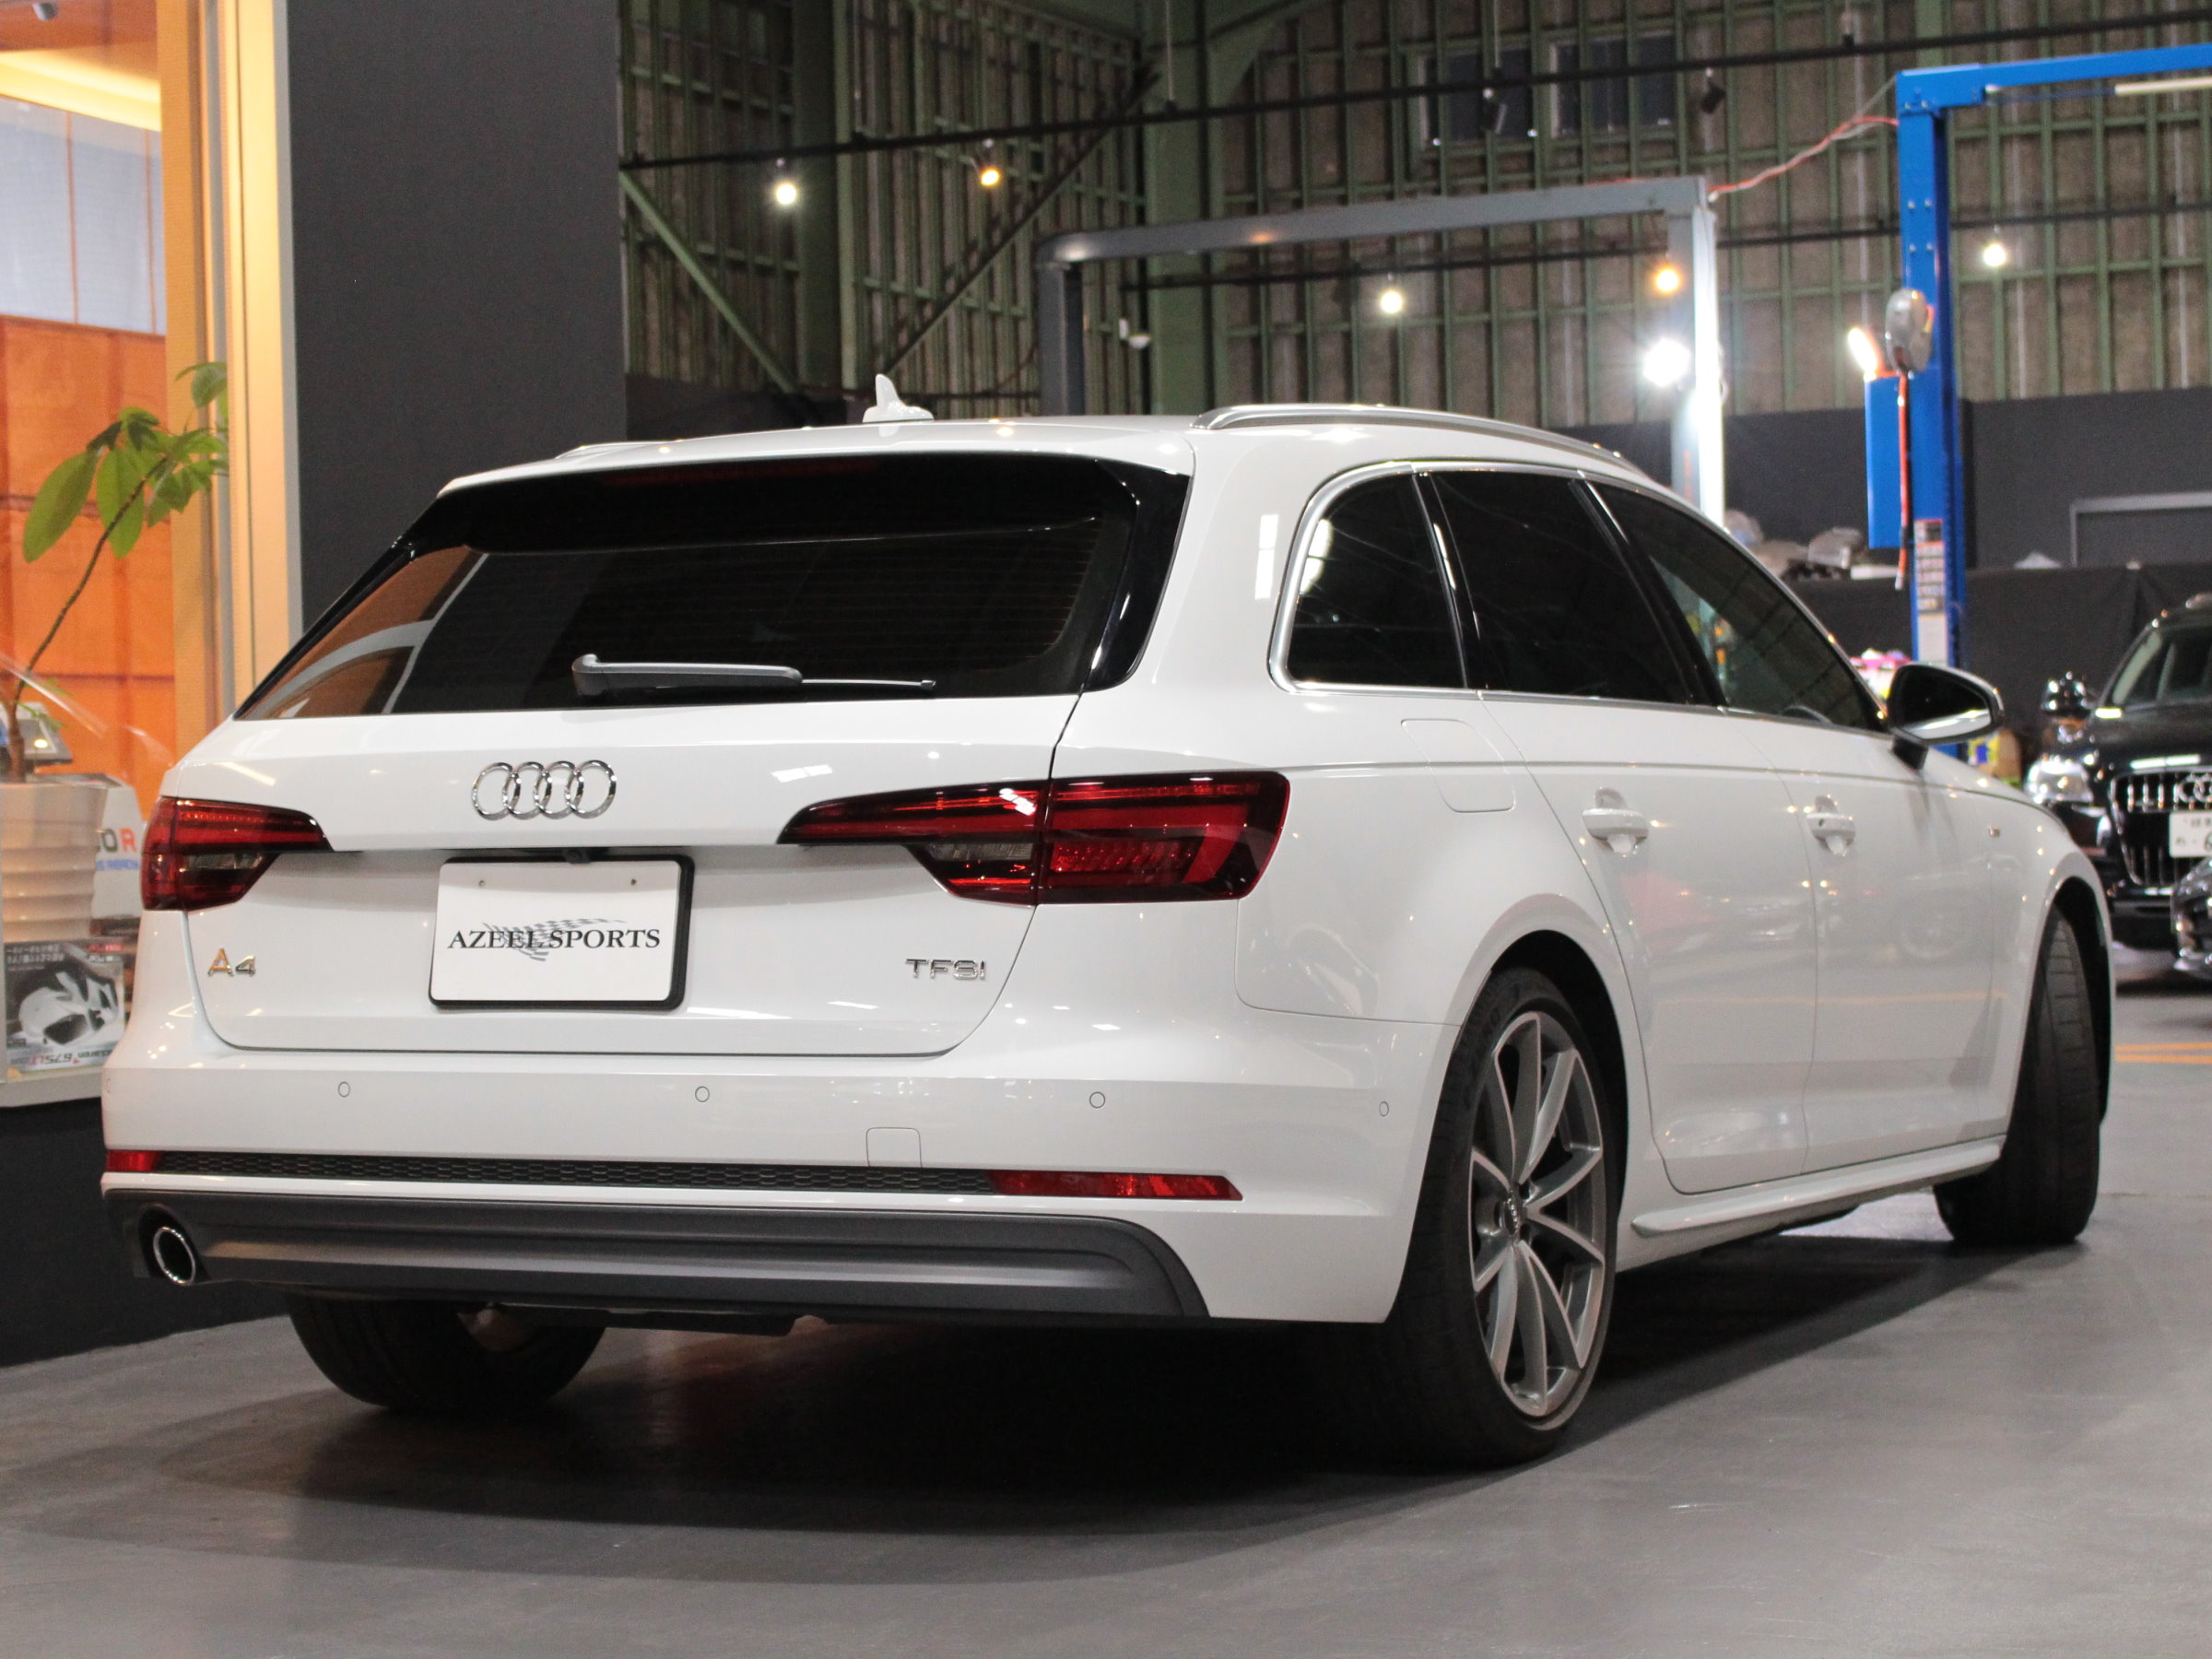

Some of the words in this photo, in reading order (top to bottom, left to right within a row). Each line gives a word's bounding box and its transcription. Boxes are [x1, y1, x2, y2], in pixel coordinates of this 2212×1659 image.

[98, 828, 137, 853] OR
[447, 930, 544, 948] AZEEL
[548, 929, 661, 948] SPORTS
[207, 947, 256, 977] A4
[905, 959, 985, 980] TFSI
